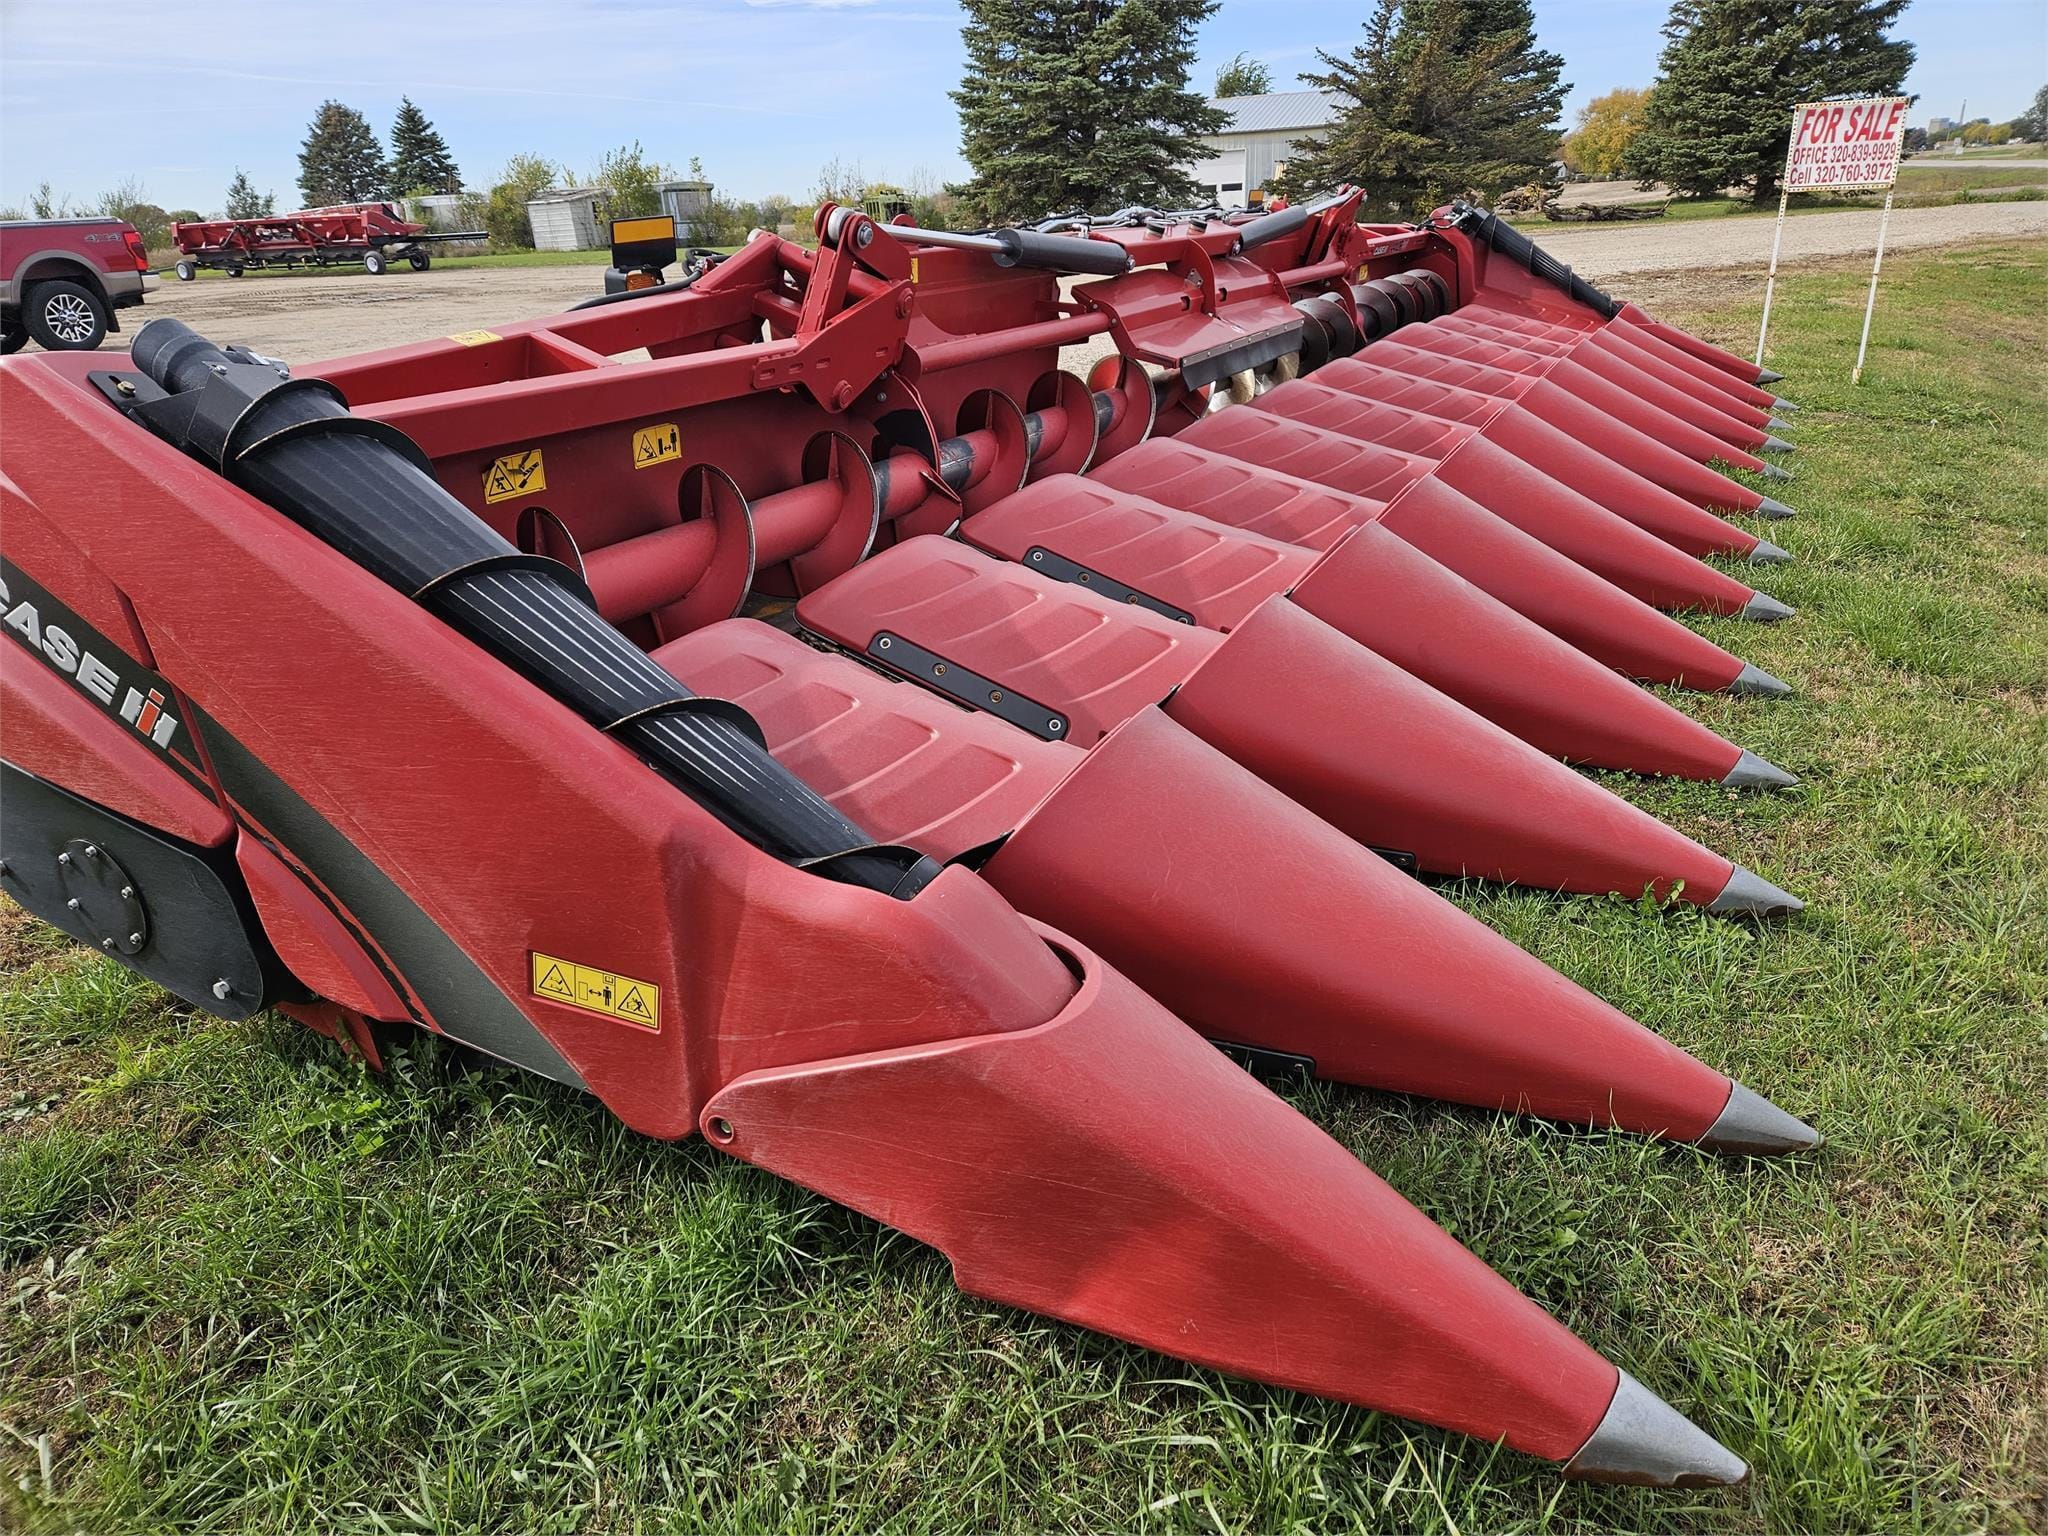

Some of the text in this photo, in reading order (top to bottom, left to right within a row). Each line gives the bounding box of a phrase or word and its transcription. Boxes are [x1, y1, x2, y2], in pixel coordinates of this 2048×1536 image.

[1797, 103, 1905, 145] FOR SALE
[1792, 143, 1896, 165] OFFICE 320-839-9929
[1790, 163, 1893, 184] Cell 320-760-3972
